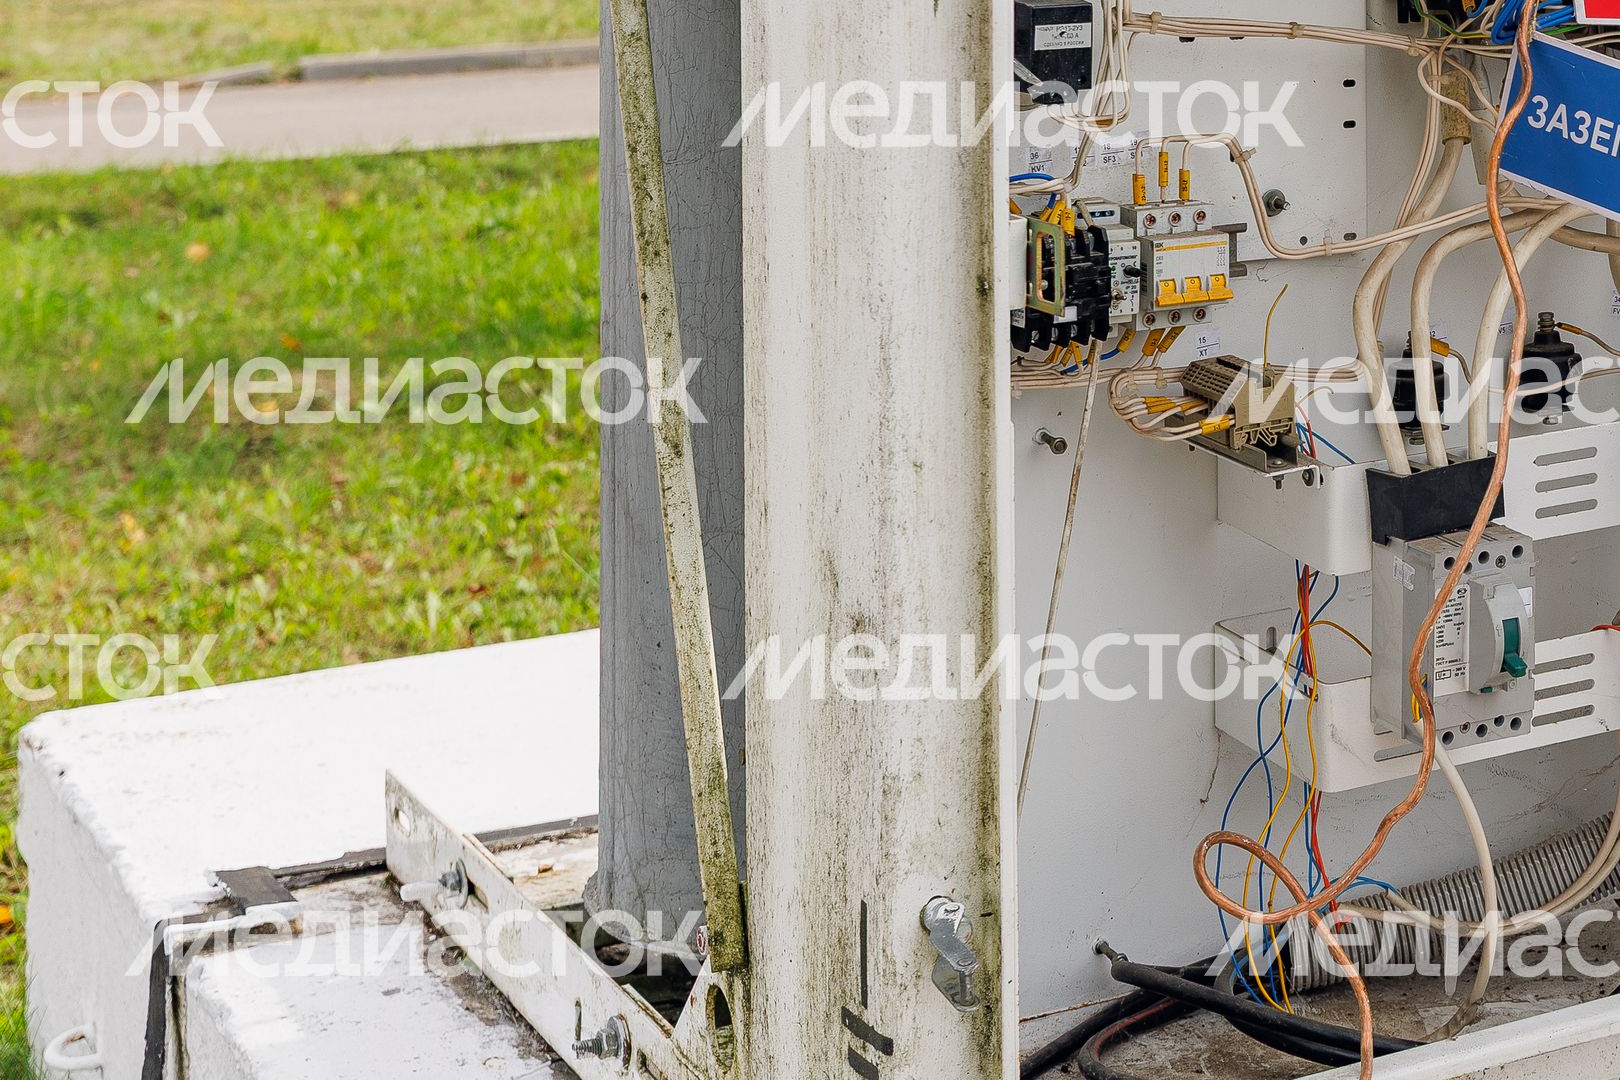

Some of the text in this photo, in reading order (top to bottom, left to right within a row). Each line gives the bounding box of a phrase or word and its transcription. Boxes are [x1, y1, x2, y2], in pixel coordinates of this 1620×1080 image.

[1030, 151, 1040, 160] 36
[1103, 156, 1117, 164] SF3
[1031, 164, 1046, 174] KV1
[1198, 336, 1207, 344] 15
[1199, 348, 1208, 357] XT
